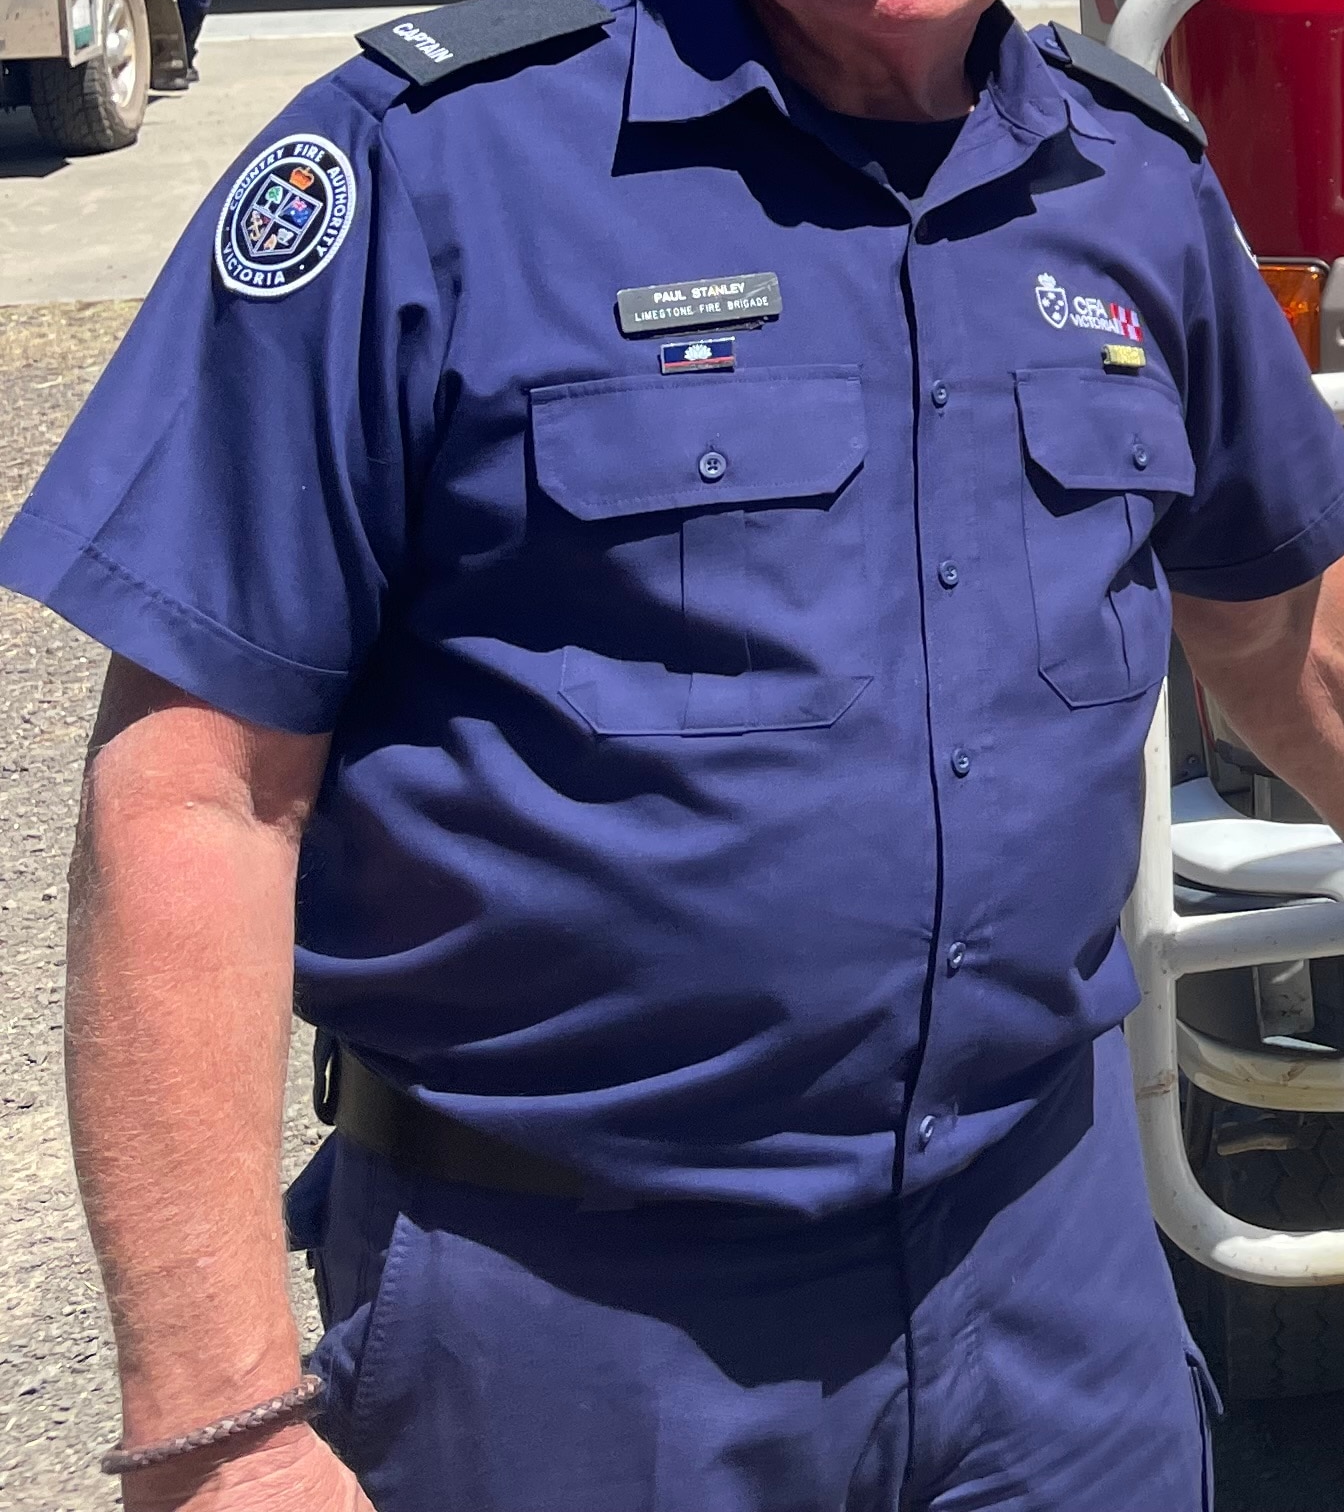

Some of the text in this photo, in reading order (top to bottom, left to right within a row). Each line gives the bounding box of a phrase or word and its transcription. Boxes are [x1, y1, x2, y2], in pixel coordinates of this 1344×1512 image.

[392, 22, 454, 63] CAPTAIN
[229, 143, 348, 258] COUNTRY FIRE AUTHORITY
[223, 241, 286, 286] VICTORIA
[653, 282, 745, 304] PAUL STANLEY
[634, 296, 769, 322] LIMESTONE FIRE BRIGADE
[1073, 296, 1109, 319] CFA
[1070, 313, 1117, 333] VICTORIA
